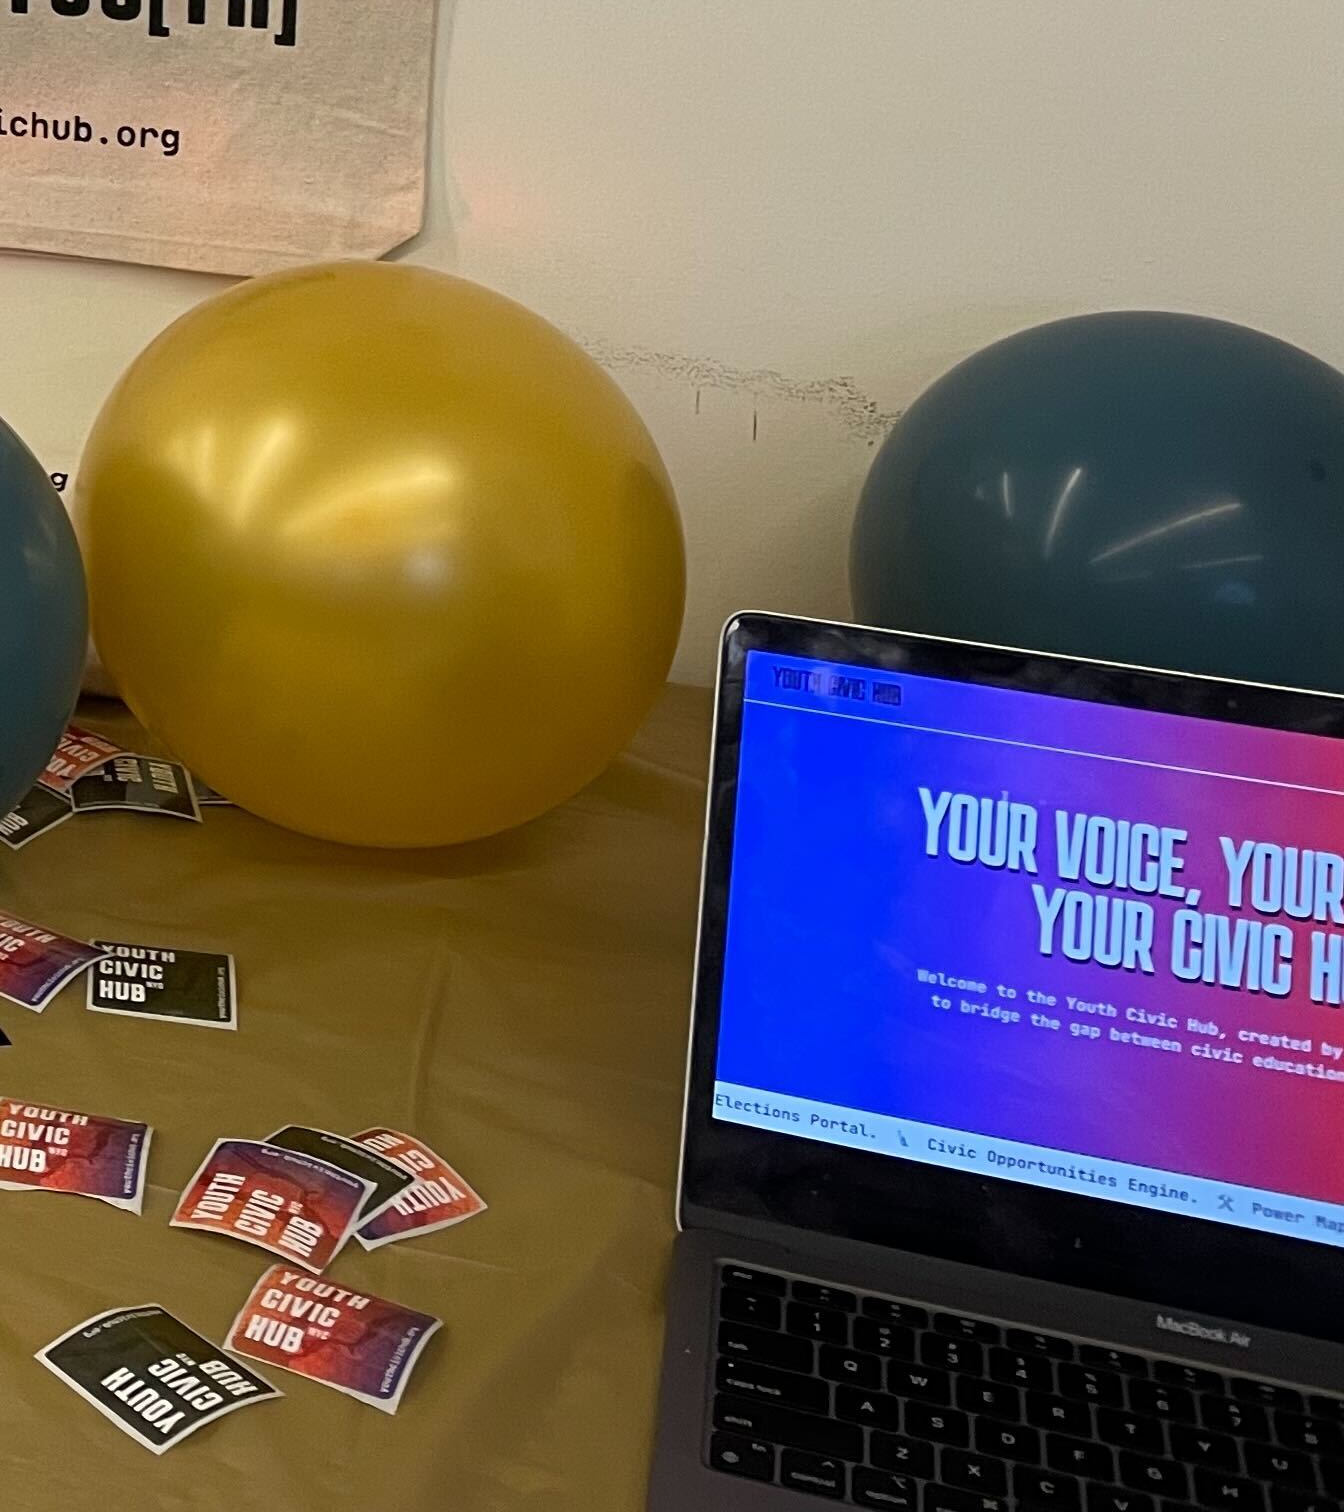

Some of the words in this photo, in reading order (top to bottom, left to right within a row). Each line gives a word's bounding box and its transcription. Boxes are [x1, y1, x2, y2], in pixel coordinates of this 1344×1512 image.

[918, 786, 1038, 874] YOUR
[1055, 809, 1202, 906] VOICE,
[1219, 835, 1344, 925] YOUR
[1031, 883, 1155, 973] YOUR
[1171, 906, 1293, 996] CIVIC
[98, 960, 163, 981] CIVIC
[99, 979, 147, 1003] HUB
[917, 968, 987, 994] Welcome
[996, 982, 1016, 1000] to
[1026, 988, 1057, 1007] the
[1066, 995, 1117, 1019] Youth
[1126, 1006, 1178, 1030] Civic
[1238, 1029, 1312, 1053] created
[1321, 1041, 1344, 1060] by
[931, 994, 952, 1011] to
[960, 998, 1021, 1024] bridge
[1030, 1011, 1061, 1031] the
[1069, 1020, 1101, 1041] gap
[1110, 1027, 1182, 1054] between
[1190, 1042, 1244, 1064] civic
[0, 1119, 71, 1145] CIVIC
[9, 1103, 89, 1126] YOUTH
[714, 1093, 800, 1123] Elections
[810, 1113, 876, 1140] Portal.
[927, 1138, 977, 1160] Civic
[987, 1150, 1118, 1188] Opportunities
[1127, 1177, 1198, 1204] Engine.
[191, 1172, 246, 1221] YOUTH
[234, 1189, 285, 1237] CIVIC
[1252, 1202, 1305, 1224] Power
[278, 1216, 324, 1258] HUB
[260, 1288, 342, 1328] CIVIC
[280, 1271, 371, 1310] YOUTH
[244, 1313, 307, 1354] HUB
[147, 1358, 224, 1412] CIVIC
[198, 1359, 259, 1397] HUB
[100, 1367, 187, 1435] YOUTH
